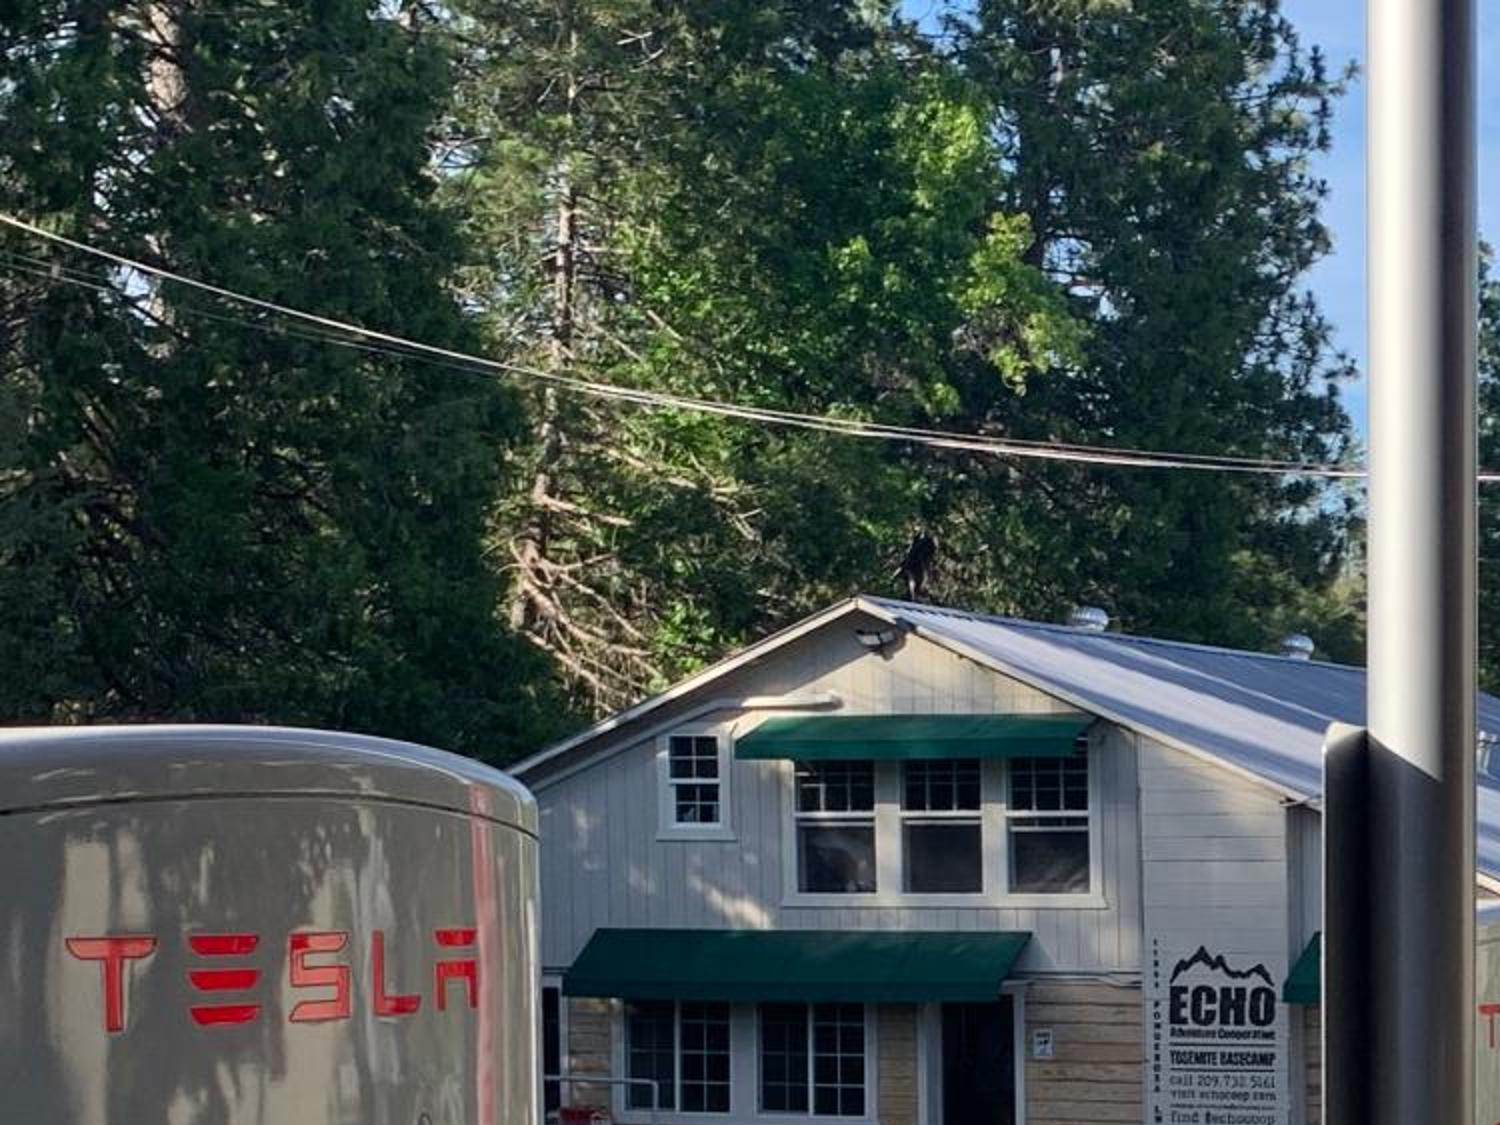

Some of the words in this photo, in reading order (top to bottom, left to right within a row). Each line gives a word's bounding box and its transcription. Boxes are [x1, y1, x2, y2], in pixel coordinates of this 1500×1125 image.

[66, 929, 479, 1033] TESLA
[1170, 985, 1276, 1026] ECHO
[1169, 1049, 1217, 1066] YOSEMITE
[1219, 1051, 1277, 1067] BASECAMP
[1169, 1074, 1192, 1087] call
